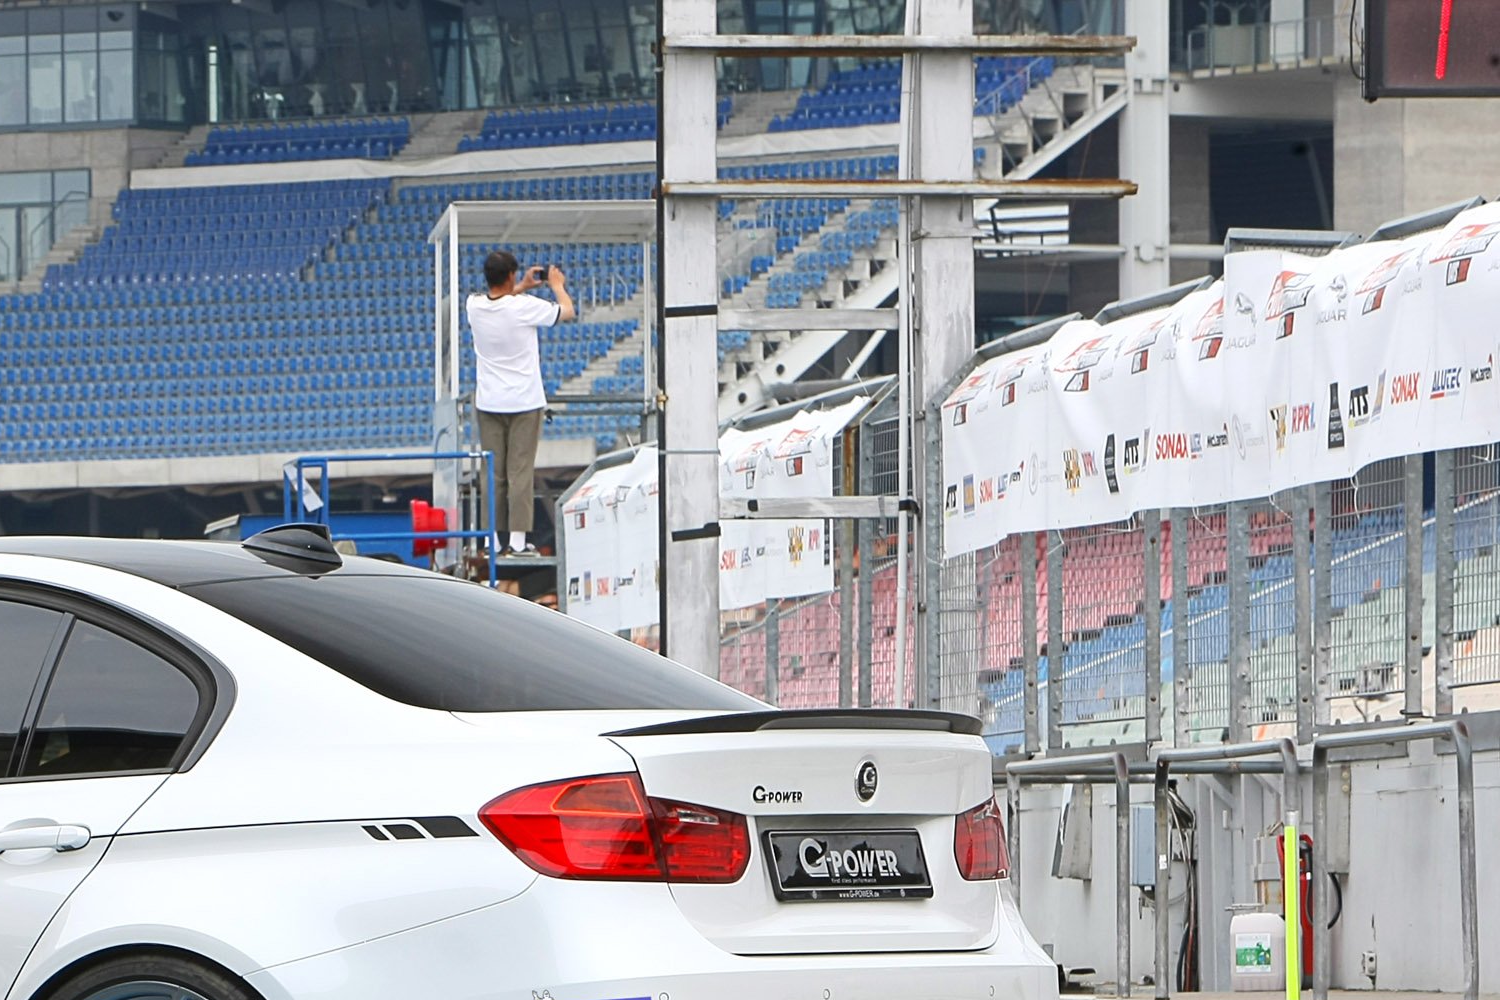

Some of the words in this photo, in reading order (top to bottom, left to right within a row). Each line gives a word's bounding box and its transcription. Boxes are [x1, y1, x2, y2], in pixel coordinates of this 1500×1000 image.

[1349, 385, 1369, 418] ATS
[1390, 372, 1420, 405] SONAX
[1431, 367, 1462, 392] ALUTEC
[1155, 433, 1189, 460] SONAX
[753, 785, 803, 803] G-POWER
[799, 837, 902, 877] G-POWER
